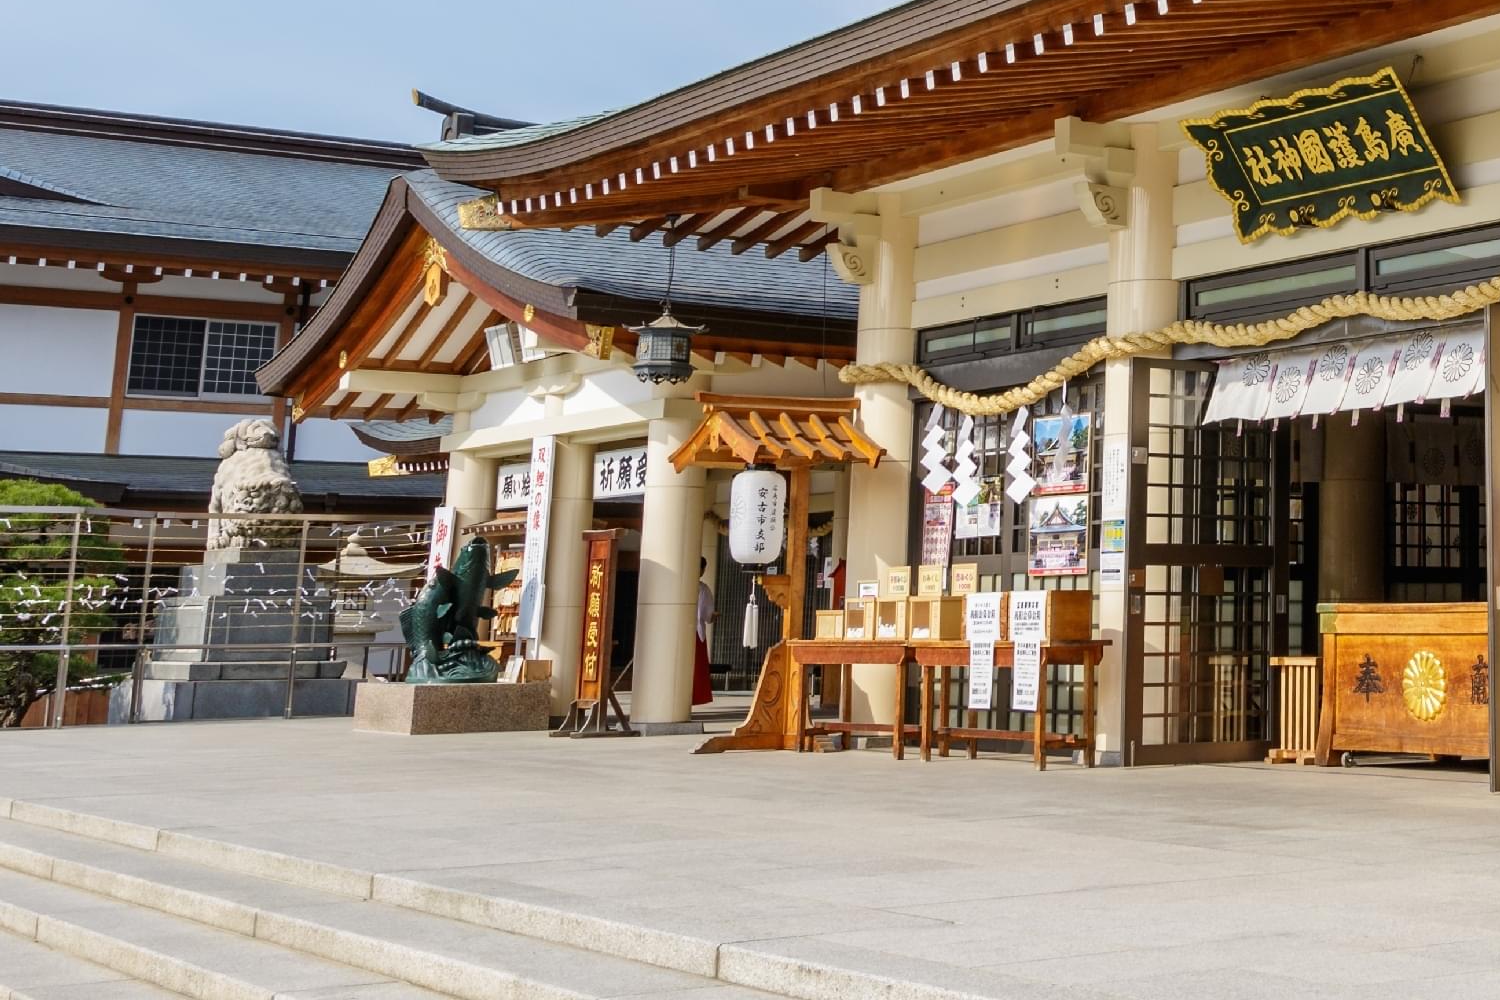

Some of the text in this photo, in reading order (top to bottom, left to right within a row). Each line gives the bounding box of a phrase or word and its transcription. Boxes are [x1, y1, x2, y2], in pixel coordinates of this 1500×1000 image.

[1243, 109, 1423, 187] 廣島護國神社
[753, 487, 768, 554] 安古市支部
[585, 563, 603, 677] 祈願受付
[1353, 653, 1384, 703] 奉
